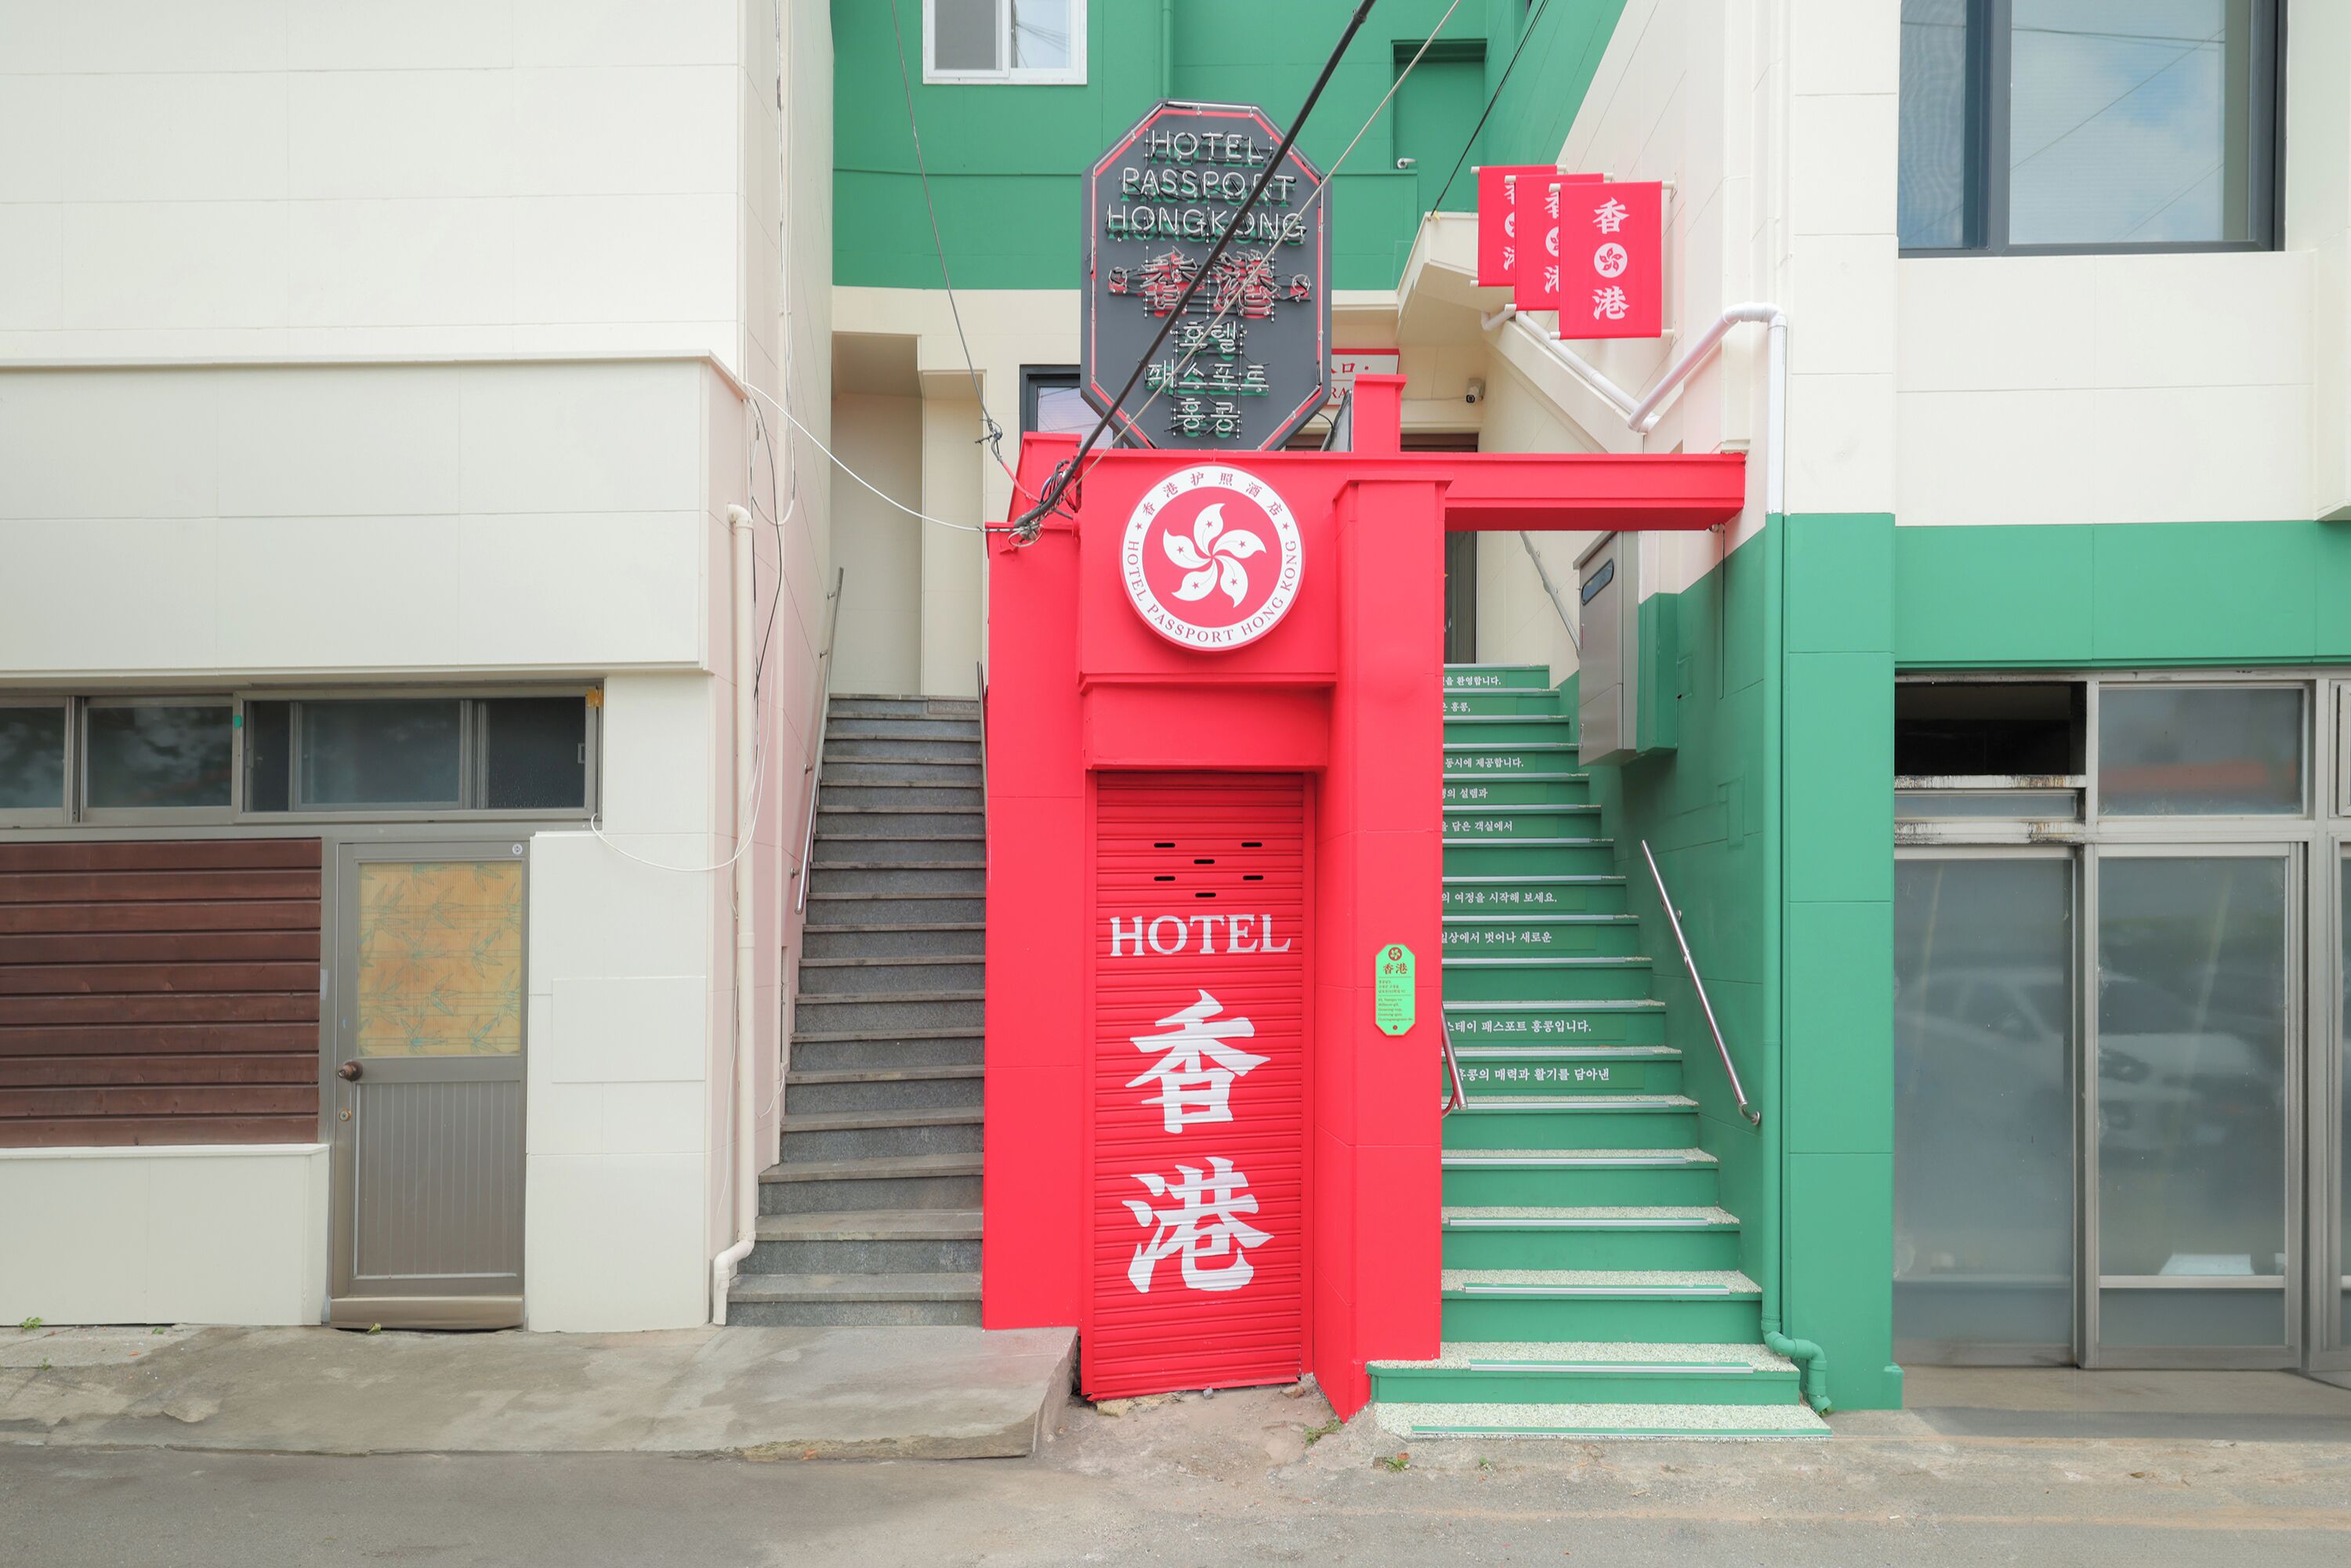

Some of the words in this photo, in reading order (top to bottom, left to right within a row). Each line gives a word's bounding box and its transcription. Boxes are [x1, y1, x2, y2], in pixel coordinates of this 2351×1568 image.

[1150, 129, 1265, 165] HOTEL
[1106, 203, 1307, 242] HONGKONG
[1177, 320, 1237, 357] 호텔
[1145, 358, 1270, 393] 패스포트
[1176, 397, 1240, 434] 홍콩
[1142, 472, 1283, 516] 香港护照酒店
[1127, 540, 1146, 601] HOTEL
[1147, 603, 1234, 643] PASSPORT
[1241, 596, 1284, 636] HONG
[1281, 540, 1298, 592] KONG
[1457, 675, 1502, 686] 환영합니다.
[1445, 757, 1472, 768] 동시에
[1476, 757, 1523, 768] 제공합니다.
[1460, 788, 1488, 798] 설렘과
[1452, 820, 1471, 832] 담은
[1475, 820, 1513, 832] 객실에서
[1454, 892, 1485, 904] 여정을
[1489, 892, 1520, 904] 시작해
[1523, 891, 1558, 904] 보세요.
[1110, 914, 1291, 956] HOTEL
[1484, 931, 1516, 944] 벗어나
[1520, 931, 1552, 943] 새로운
[1383, 962, 1408, 975] 香港
[1481, 1020, 1527, 1033] 패스포트
[1531, 1019, 1592, 1033] 홍콩입니다.
[1494, 1068, 1531, 1081] 매력과
[1534, 1068, 1570, 1081] 활기를
[1574, 1067, 1610, 1081] 담아낸
[1121, 988, 1275, 1294] 香港
